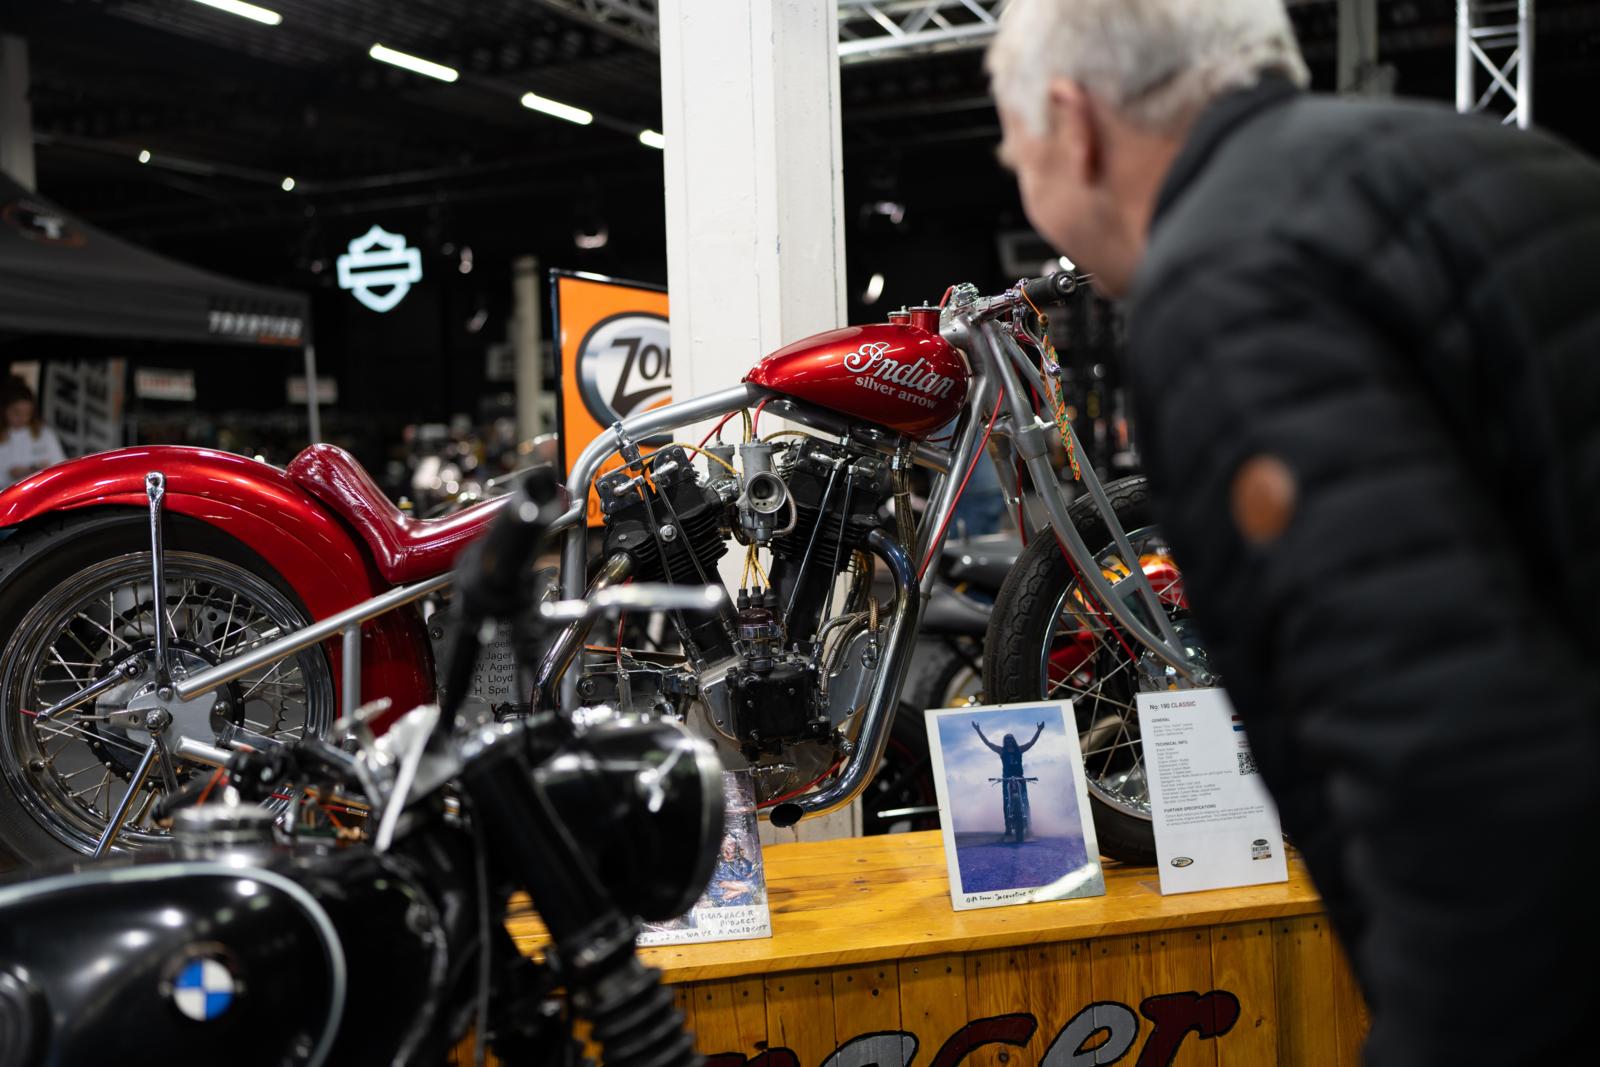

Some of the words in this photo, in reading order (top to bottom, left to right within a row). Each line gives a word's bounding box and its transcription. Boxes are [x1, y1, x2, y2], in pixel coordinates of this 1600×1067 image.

[844, 342, 955, 399] Indian
[855, 376, 896, 396] silver
[898, 390, 938, 409] arrow
[488, 674, 513, 684] Lloyd
[1171, 701, 1197, 709] CLASSIC
